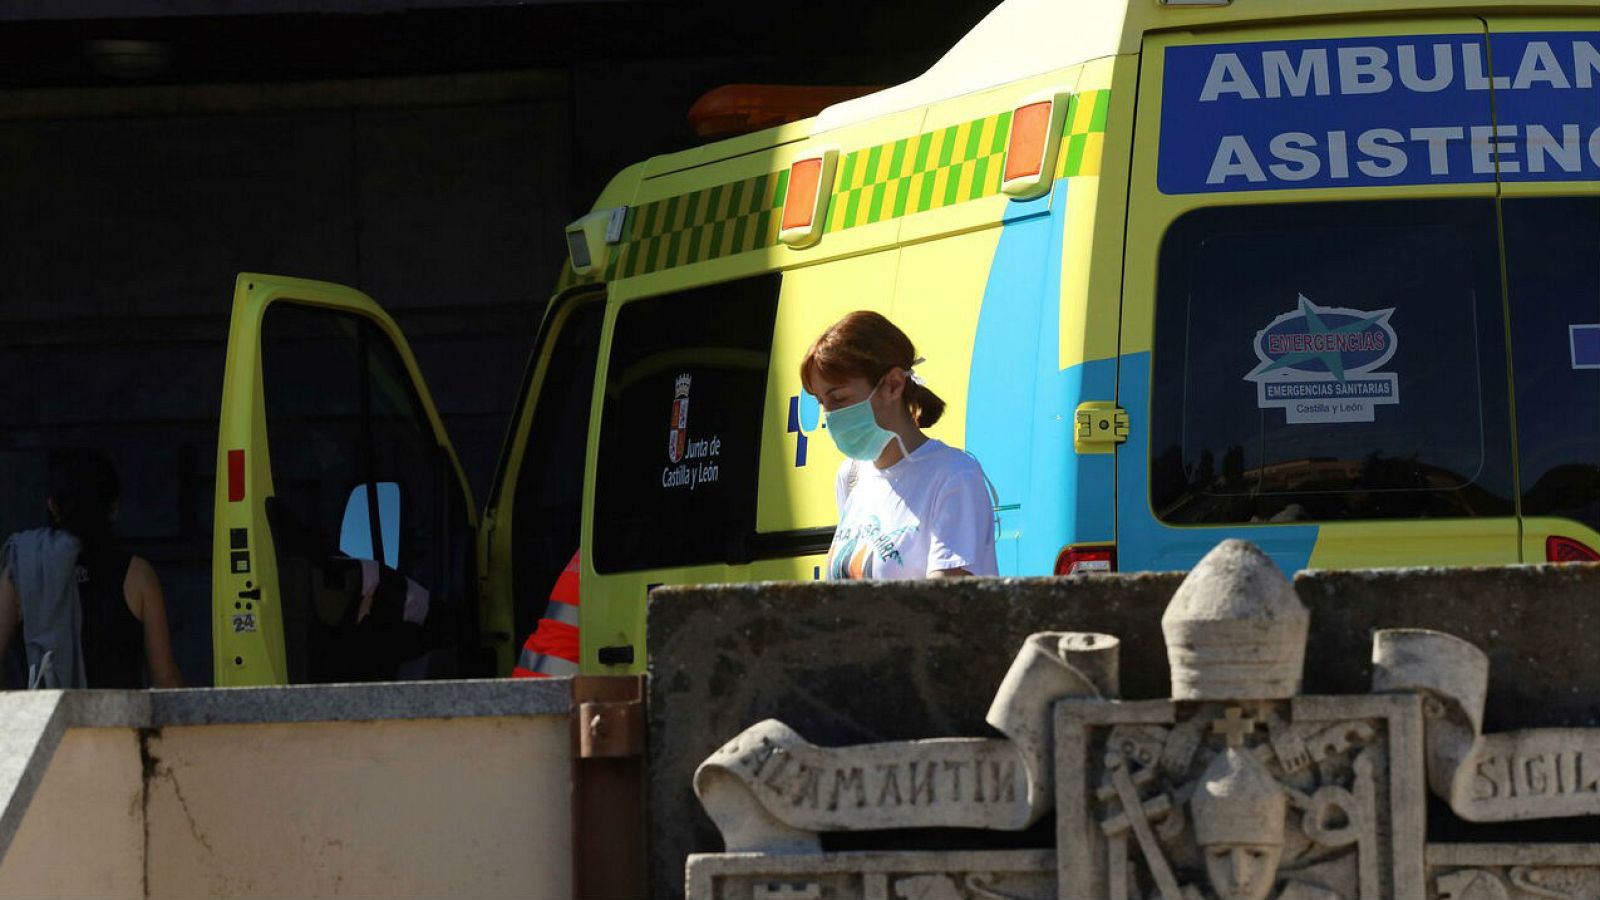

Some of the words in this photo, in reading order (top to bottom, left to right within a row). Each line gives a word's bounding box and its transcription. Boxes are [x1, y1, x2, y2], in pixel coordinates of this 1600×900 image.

[1206, 123, 1600, 184] ASISTEN
[1268, 331, 1386, 353] EMERGENCIAS
[1267, 383, 1334, 397] EMERGENCIAS
[1336, 382, 1390, 396] SANITARIAS
[1296, 403, 1330, 414] Castilla
[1340, 402, 1363, 412] León
[685, 437, 708, 460] Junta
[709, 435, 721, 456] de
[662, 464, 690, 488] Castilla
[689, 467, 698, 491] y
[698, 460, 719, 483] León
